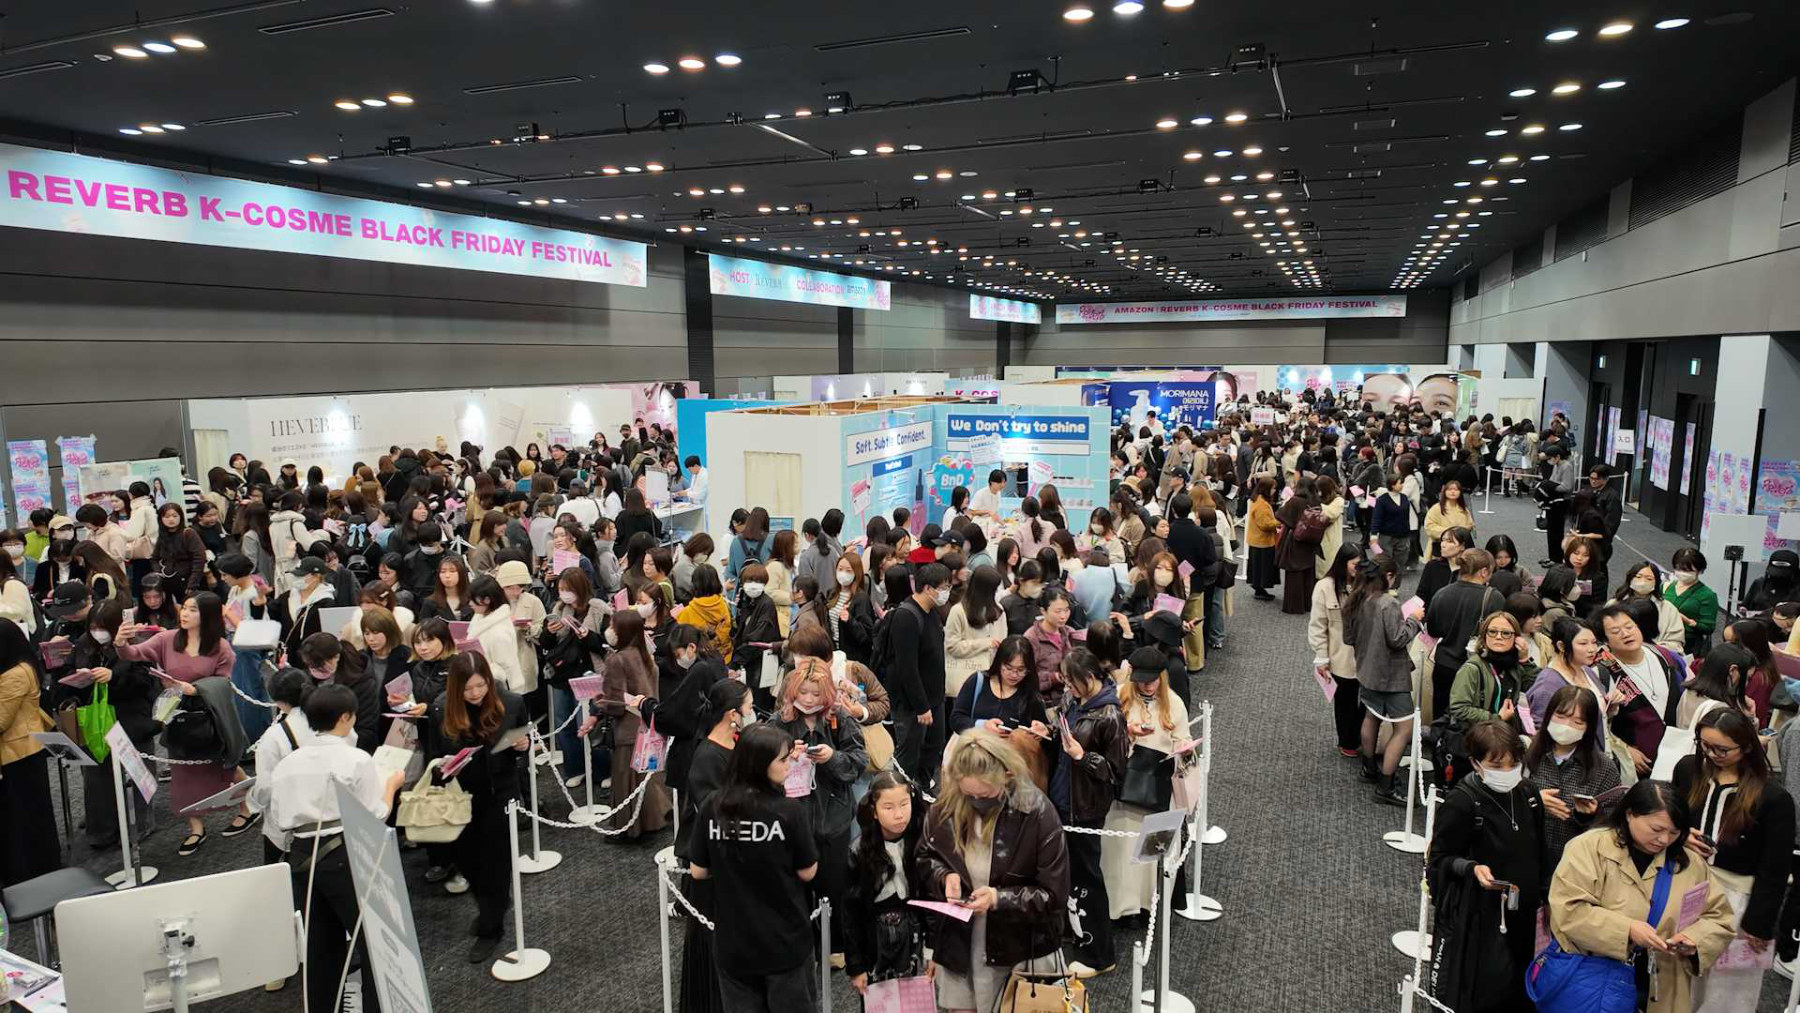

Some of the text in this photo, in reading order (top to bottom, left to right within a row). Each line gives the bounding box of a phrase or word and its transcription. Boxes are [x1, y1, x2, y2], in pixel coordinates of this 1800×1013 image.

[8, 169, 612, 268] REVERB K-COSME BLACK FRIDAY FESTIVAL
[730, 270, 751, 284] HOST
[797, 279, 844, 295] COLLABORATION
[1114, 300, 1378, 314] AMAZON REVERB K-COSME BLACK FRIDAY FESTIVAL
[1160, 389, 1209, 398] MORIMANA
[271, 415, 362, 437] HEVEBE
[950, 419, 1086, 434] We Don't try to shine
